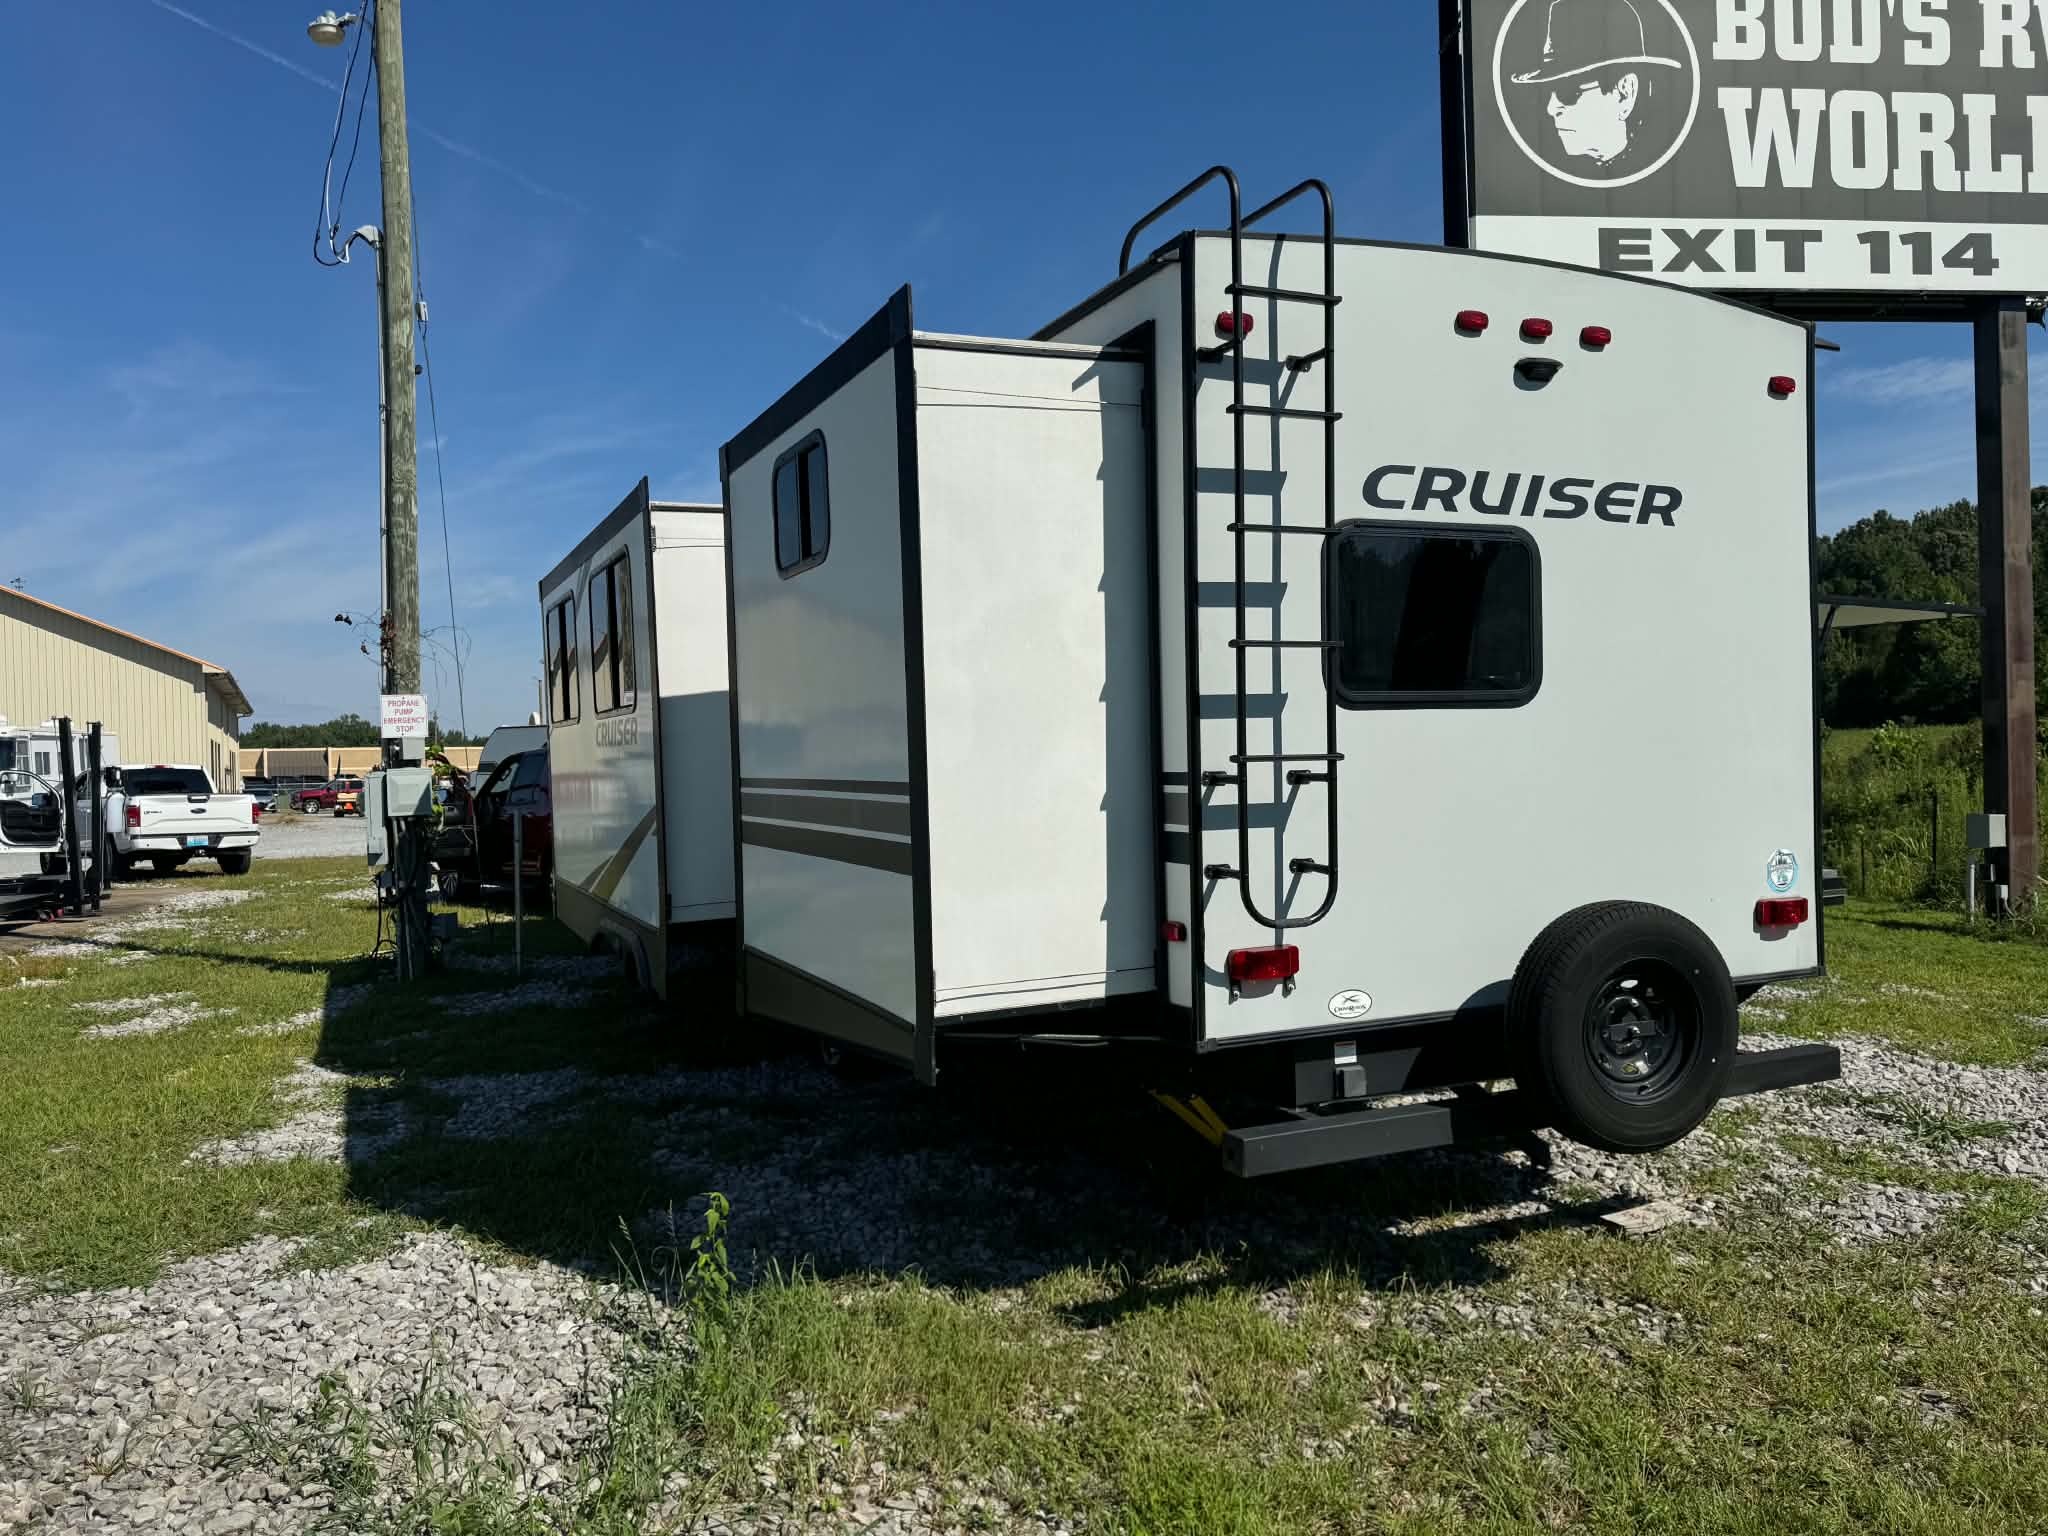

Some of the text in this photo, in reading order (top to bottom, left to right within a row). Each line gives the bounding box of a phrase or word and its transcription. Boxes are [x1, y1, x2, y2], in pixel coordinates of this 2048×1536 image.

[1979, 0, 2048, 68] R
[1598, 228, 2000, 276] EXIT 114
[1362, 464, 1684, 527] CRUISER
[384, 716, 425, 724] EMERGENCY
[596, 717, 638, 748] CRUISER
